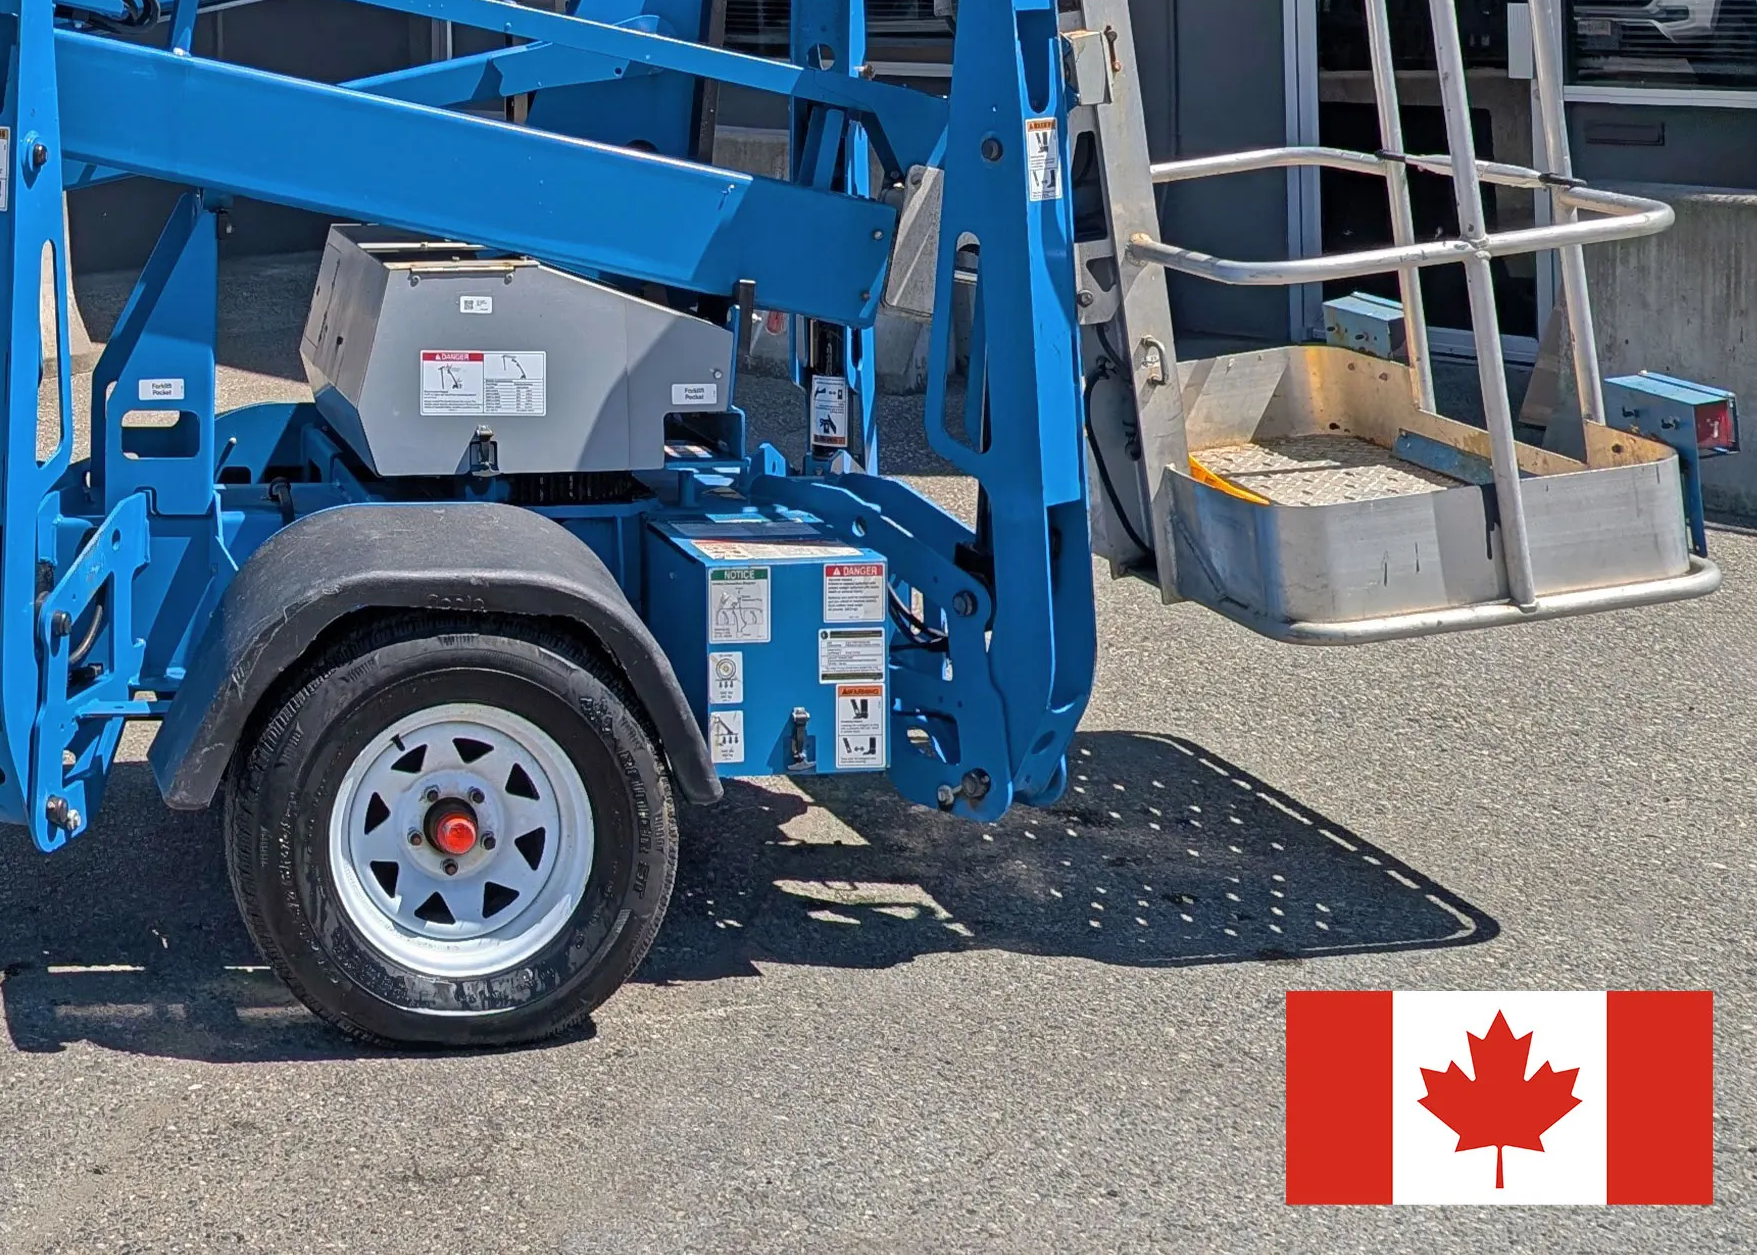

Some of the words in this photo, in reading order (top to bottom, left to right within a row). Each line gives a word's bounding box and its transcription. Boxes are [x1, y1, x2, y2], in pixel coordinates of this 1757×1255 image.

[441, 353, 470, 362] DANGER
[724, 569, 755, 580] NOTICE
[843, 565, 878, 576] DANGER
